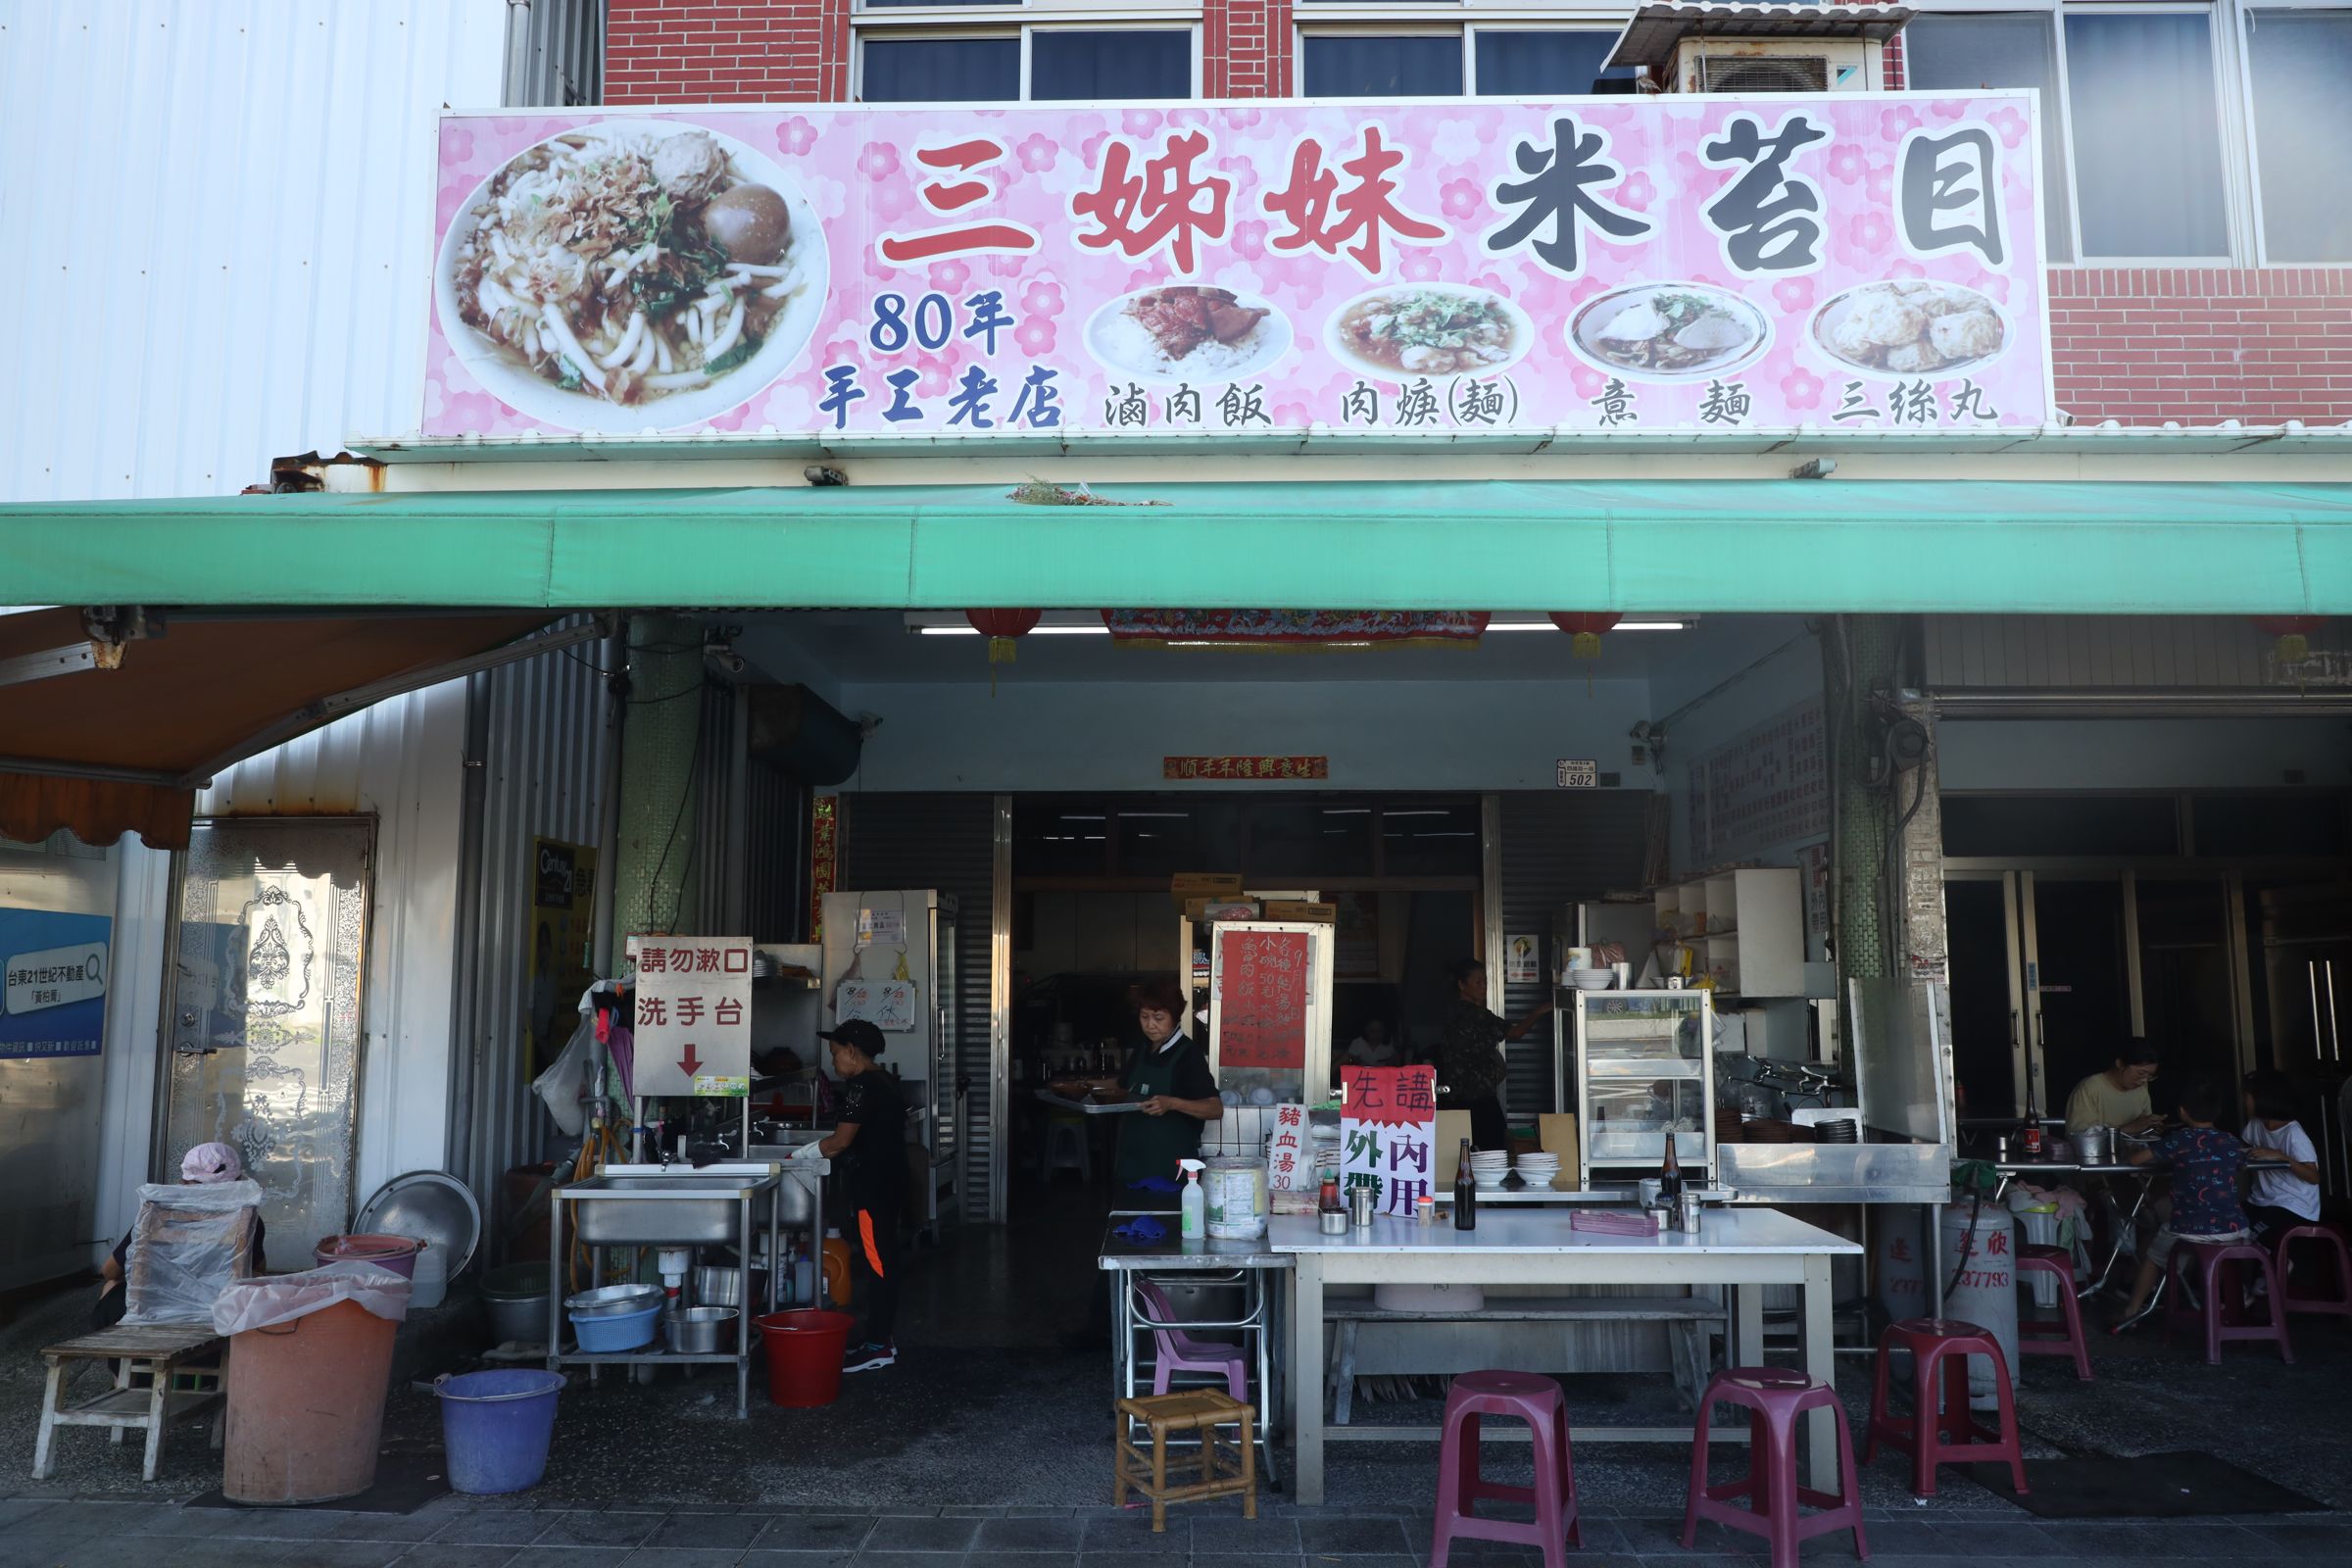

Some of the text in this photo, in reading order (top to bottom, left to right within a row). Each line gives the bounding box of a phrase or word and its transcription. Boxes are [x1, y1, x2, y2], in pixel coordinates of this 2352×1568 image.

[880, 115, 2006, 275] 三姊妹米苔目
[870, 289, 1015, 355] 80年
[819, 365, 1063, 430] 手工老店
[1104, 382, 1273, 426] 滷肉飯
[1831, 377, 1999, 425] 三絲丸
[1569, 774, 1592, 786] 502
[640, 947, 749, 973] 請勿漱口
[637, 997, 744, 1027] 洗手台
[1273, 1106, 1301, 1190] 豬血湯 30
